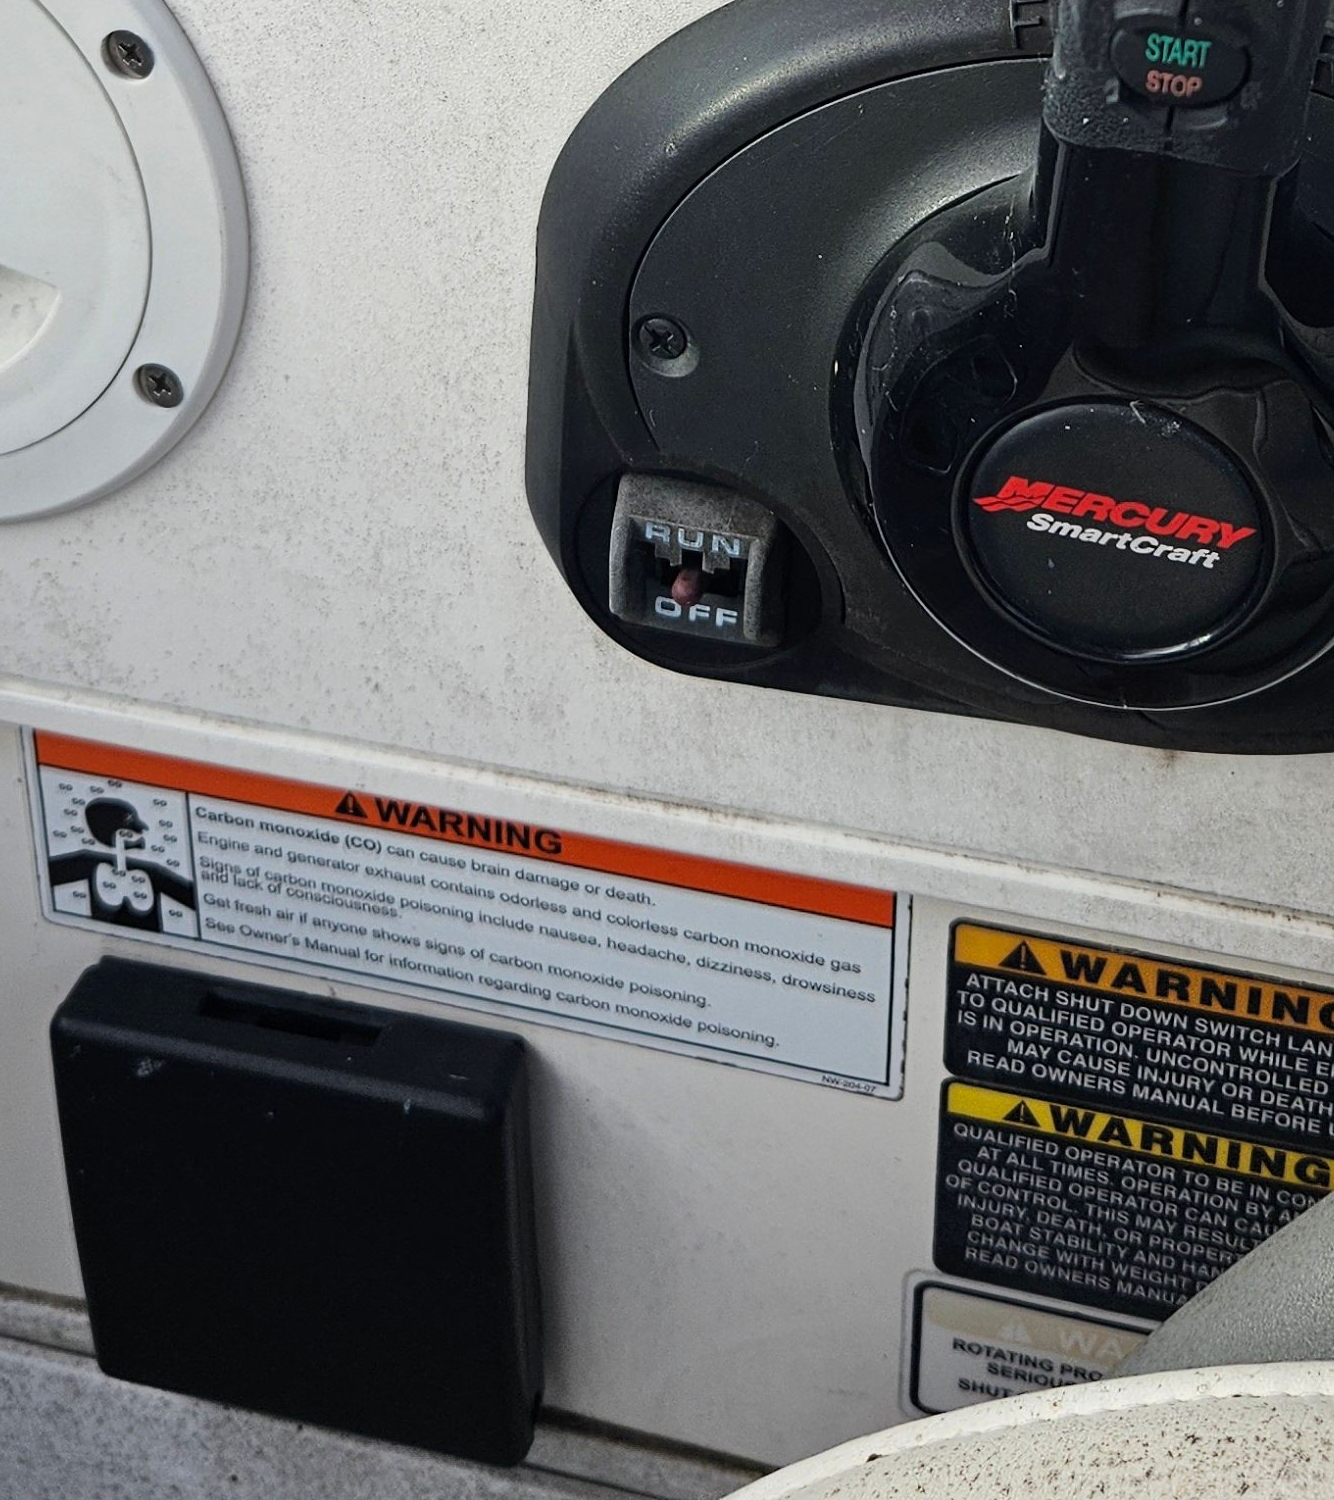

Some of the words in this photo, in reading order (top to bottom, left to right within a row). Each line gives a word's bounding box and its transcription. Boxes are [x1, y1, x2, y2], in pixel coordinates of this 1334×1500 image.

[1144, 32, 1212, 69] START
[1145, 68, 1204, 98] STOP
[644, 520, 743, 556] RUN
[973, 475, 1257, 549] MERCURY
[1025, 512, 1221, 569] SmartCraft
[654, 596, 739, 627] OFF
[196, 806, 254, 829] Carbon
[259, 821, 340, 846] monoxide
[345, 835, 381, 856] (CO)
[387, 846, 414, 860] can
[420, 852, 466, 870] cause
[471, 859, 510, 879] brain
[515, 868, 580, 893] damage
[585, 884, 601, 896] or
[606, 885, 656, 907] death.
[373, 795, 564, 856] WARNING
[198, 831, 249, 853] Engine
[254, 845, 282, 859] and
[288, 852, 359, 875] generator
[366, 867, 425, 888] exhaust
[431, 880, 495, 902] contains
[500, 893, 567, 916] odorless
[573, 908, 601, 922] and
[607, 915, 678, 938] colorless
[683, 930, 739, 950] carbon
[744, 942, 825, 967] monoxide
[831, 959, 861, 974] gas
[202, 869, 228, 884] and
[234, 873, 263, 890] lack
[268, 881, 281, 894] of
[200, 856, 241, 876] Signs
[247, 867, 260, 879] of
[265, 872, 316, 890] carbon
[322, 883, 395, 906] monoxide
[400, 899, 473, 924] poisoning
[479, 912, 533, 934] include
[782, 972, 875, 1002] drowsiness
[204, 893, 230, 910] Get
[235, 899, 271, 918] fresh
[277, 909, 294, 922] air
[300, 912, 308, 925] if
[312, 917, 367, 937] anyone
[373, 928, 420, 948] shows
[425, 939, 465, 957] signs
[471, 948, 485, 961] of
[489, 953, 543, 972] carbon
[548, 965, 623, 988] monoxide
[205, 917, 235, 935] See
[305, 937, 360, 960] Manual
[365, 949, 385, 965] for
[390, 954, 473, 983] information
[479, 975, 551, 1001] regarding
[556, 990, 610, 1010] carbon
[616, 1003, 691, 1027] monoxide
[957, 990, 984, 1009] TO
[992, 997, 1104, 1032] QUALIFIED
[1112, 1021, 1230, 1057] OPERATOR
[1239, 1045, 1308, 1072] WHILE
[967, 972, 1048, 1001] ATTACH
[1056, 989, 1115, 1014] SHUT
[1121, 1002, 1187, 1029] DOWN
[1195, 1017, 1280, 1047] SWITCH
[958, 1010, 976, 1026] IS
[983, 1015, 1003, 1032] IN
[1011, 1020, 1138, 1058] OPERATION.
[1146, 1047, 1328, 1095] UNCONTROLLED
[1008, 1040, 1050, 1061] MAY
[1058, 1049, 1130, 1076] CAUSE
[1137, 1065, 1215, 1093] INJURY
[1222, 1081, 1252, 1100] OR
[968, 1051, 1025, 1075] READ
[1032, 1064, 1126, 1095] OWNERS
[1133, 1084, 1224, 1115] MANUAL
[1232, 1104, 1320, 1134] BEFORE
[954, 1122, 1058, 1156] QUALIFIED
[1065, 1145, 1175, 1180] OPERATOR
[1182, 1169, 1209, 1187] TO
[1216, 1176, 1244, 1194] BE
[1250, 1183, 1269, 1199] IN
[1048, 1103, 1332, 1188] WARNING
[946, 1174, 973, 1192] OF
[1085, 1203, 1129, 1224] THIS
[1136, 1213, 1177, 1233] MAY
[958, 1159, 1062, 1193] QUALIFIED
[1069, 1182, 1177, 1217] OPERATOR
[1185, 1206, 1227, 1227] CAN
[977, 1146, 1002, 1164] AT
[1007, 1153, 1043, 1172] ALL
[1121, 1176, 1239, 1213] OPERATION
[1246, 1202, 1274, 1220] BY
[971, 1214, 1023, 1237] BOAT
[1029, 1226, 1128, 1259] STABILITY
[1134, 1248, 1175, 1268] AND
[1114, 1226, 1141, 1245] OR
[952, 1337, 1054, 1374] ROTATING
